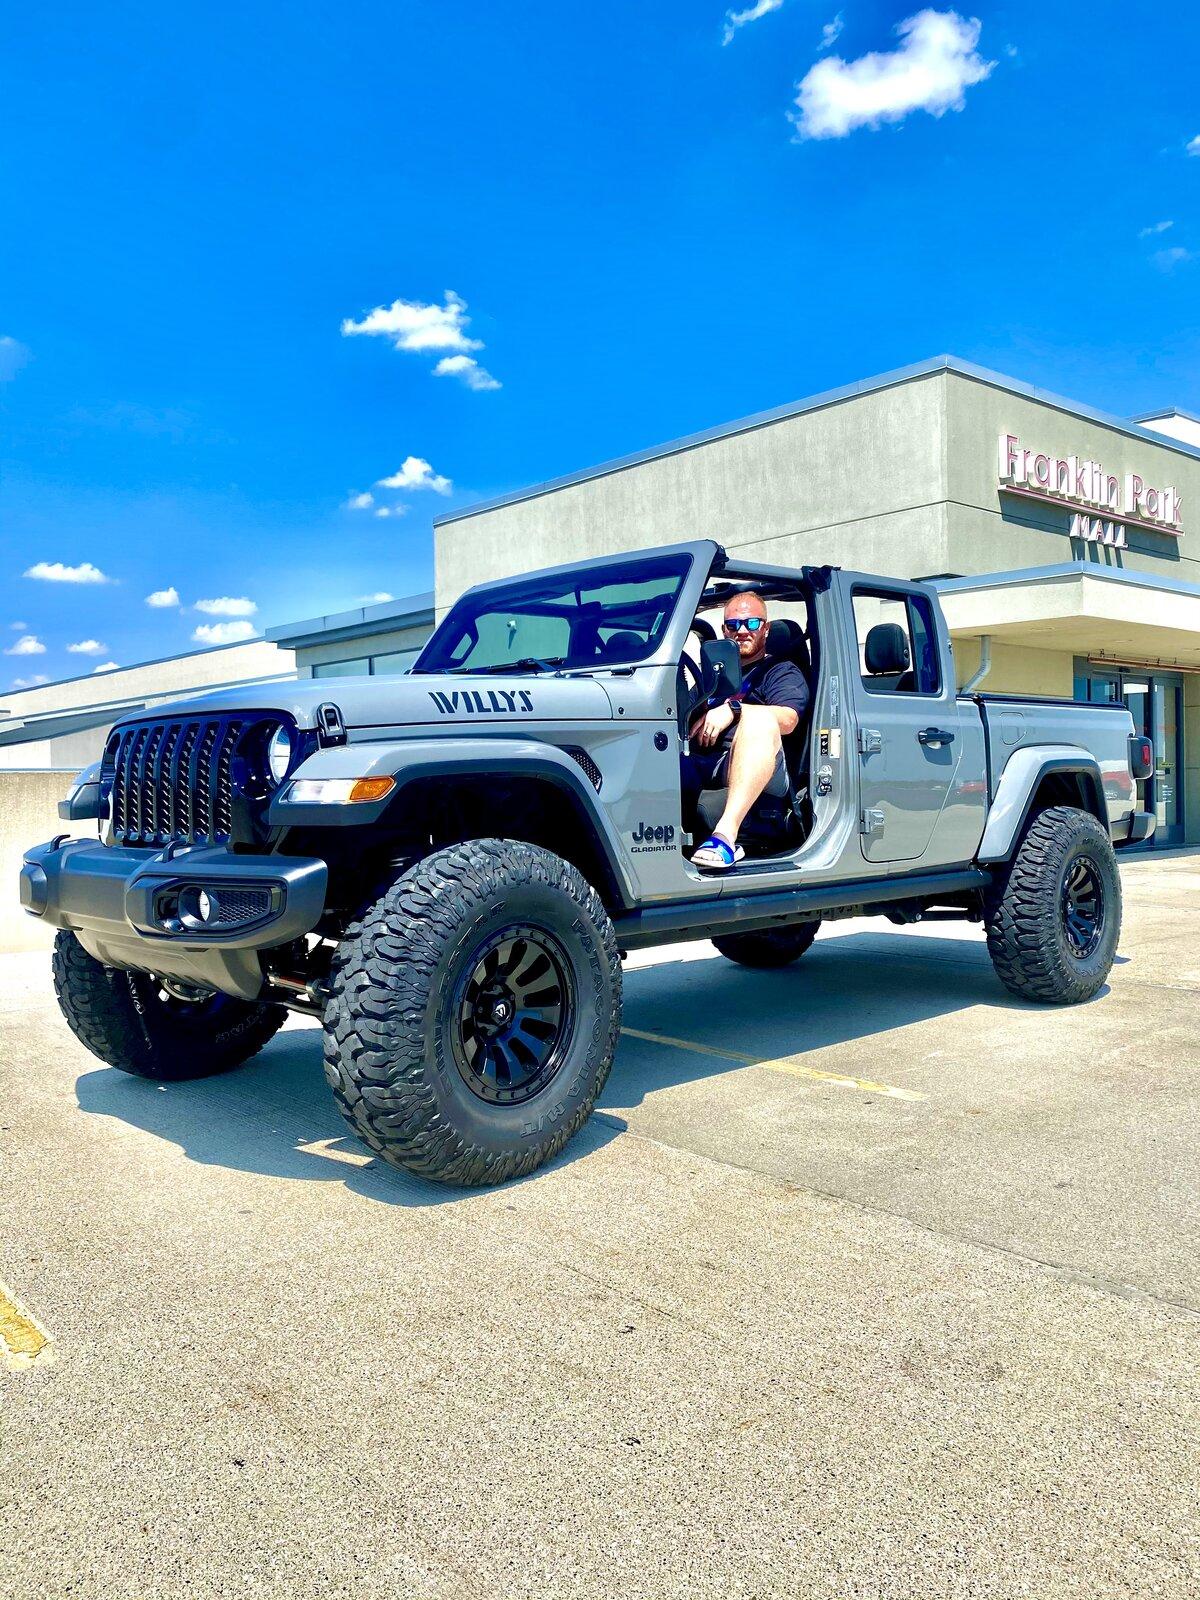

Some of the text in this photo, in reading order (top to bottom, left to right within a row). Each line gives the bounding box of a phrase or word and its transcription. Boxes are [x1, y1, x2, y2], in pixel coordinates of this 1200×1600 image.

[999, 434, 1184, 525] Franklin Park
[1069, 513, 1128, 548] MALL
[428, 690, 534, 714] WILLYS
[632, 821, 675, 844] Jeep
[630, 845, 677, 853] GLADIATOR
